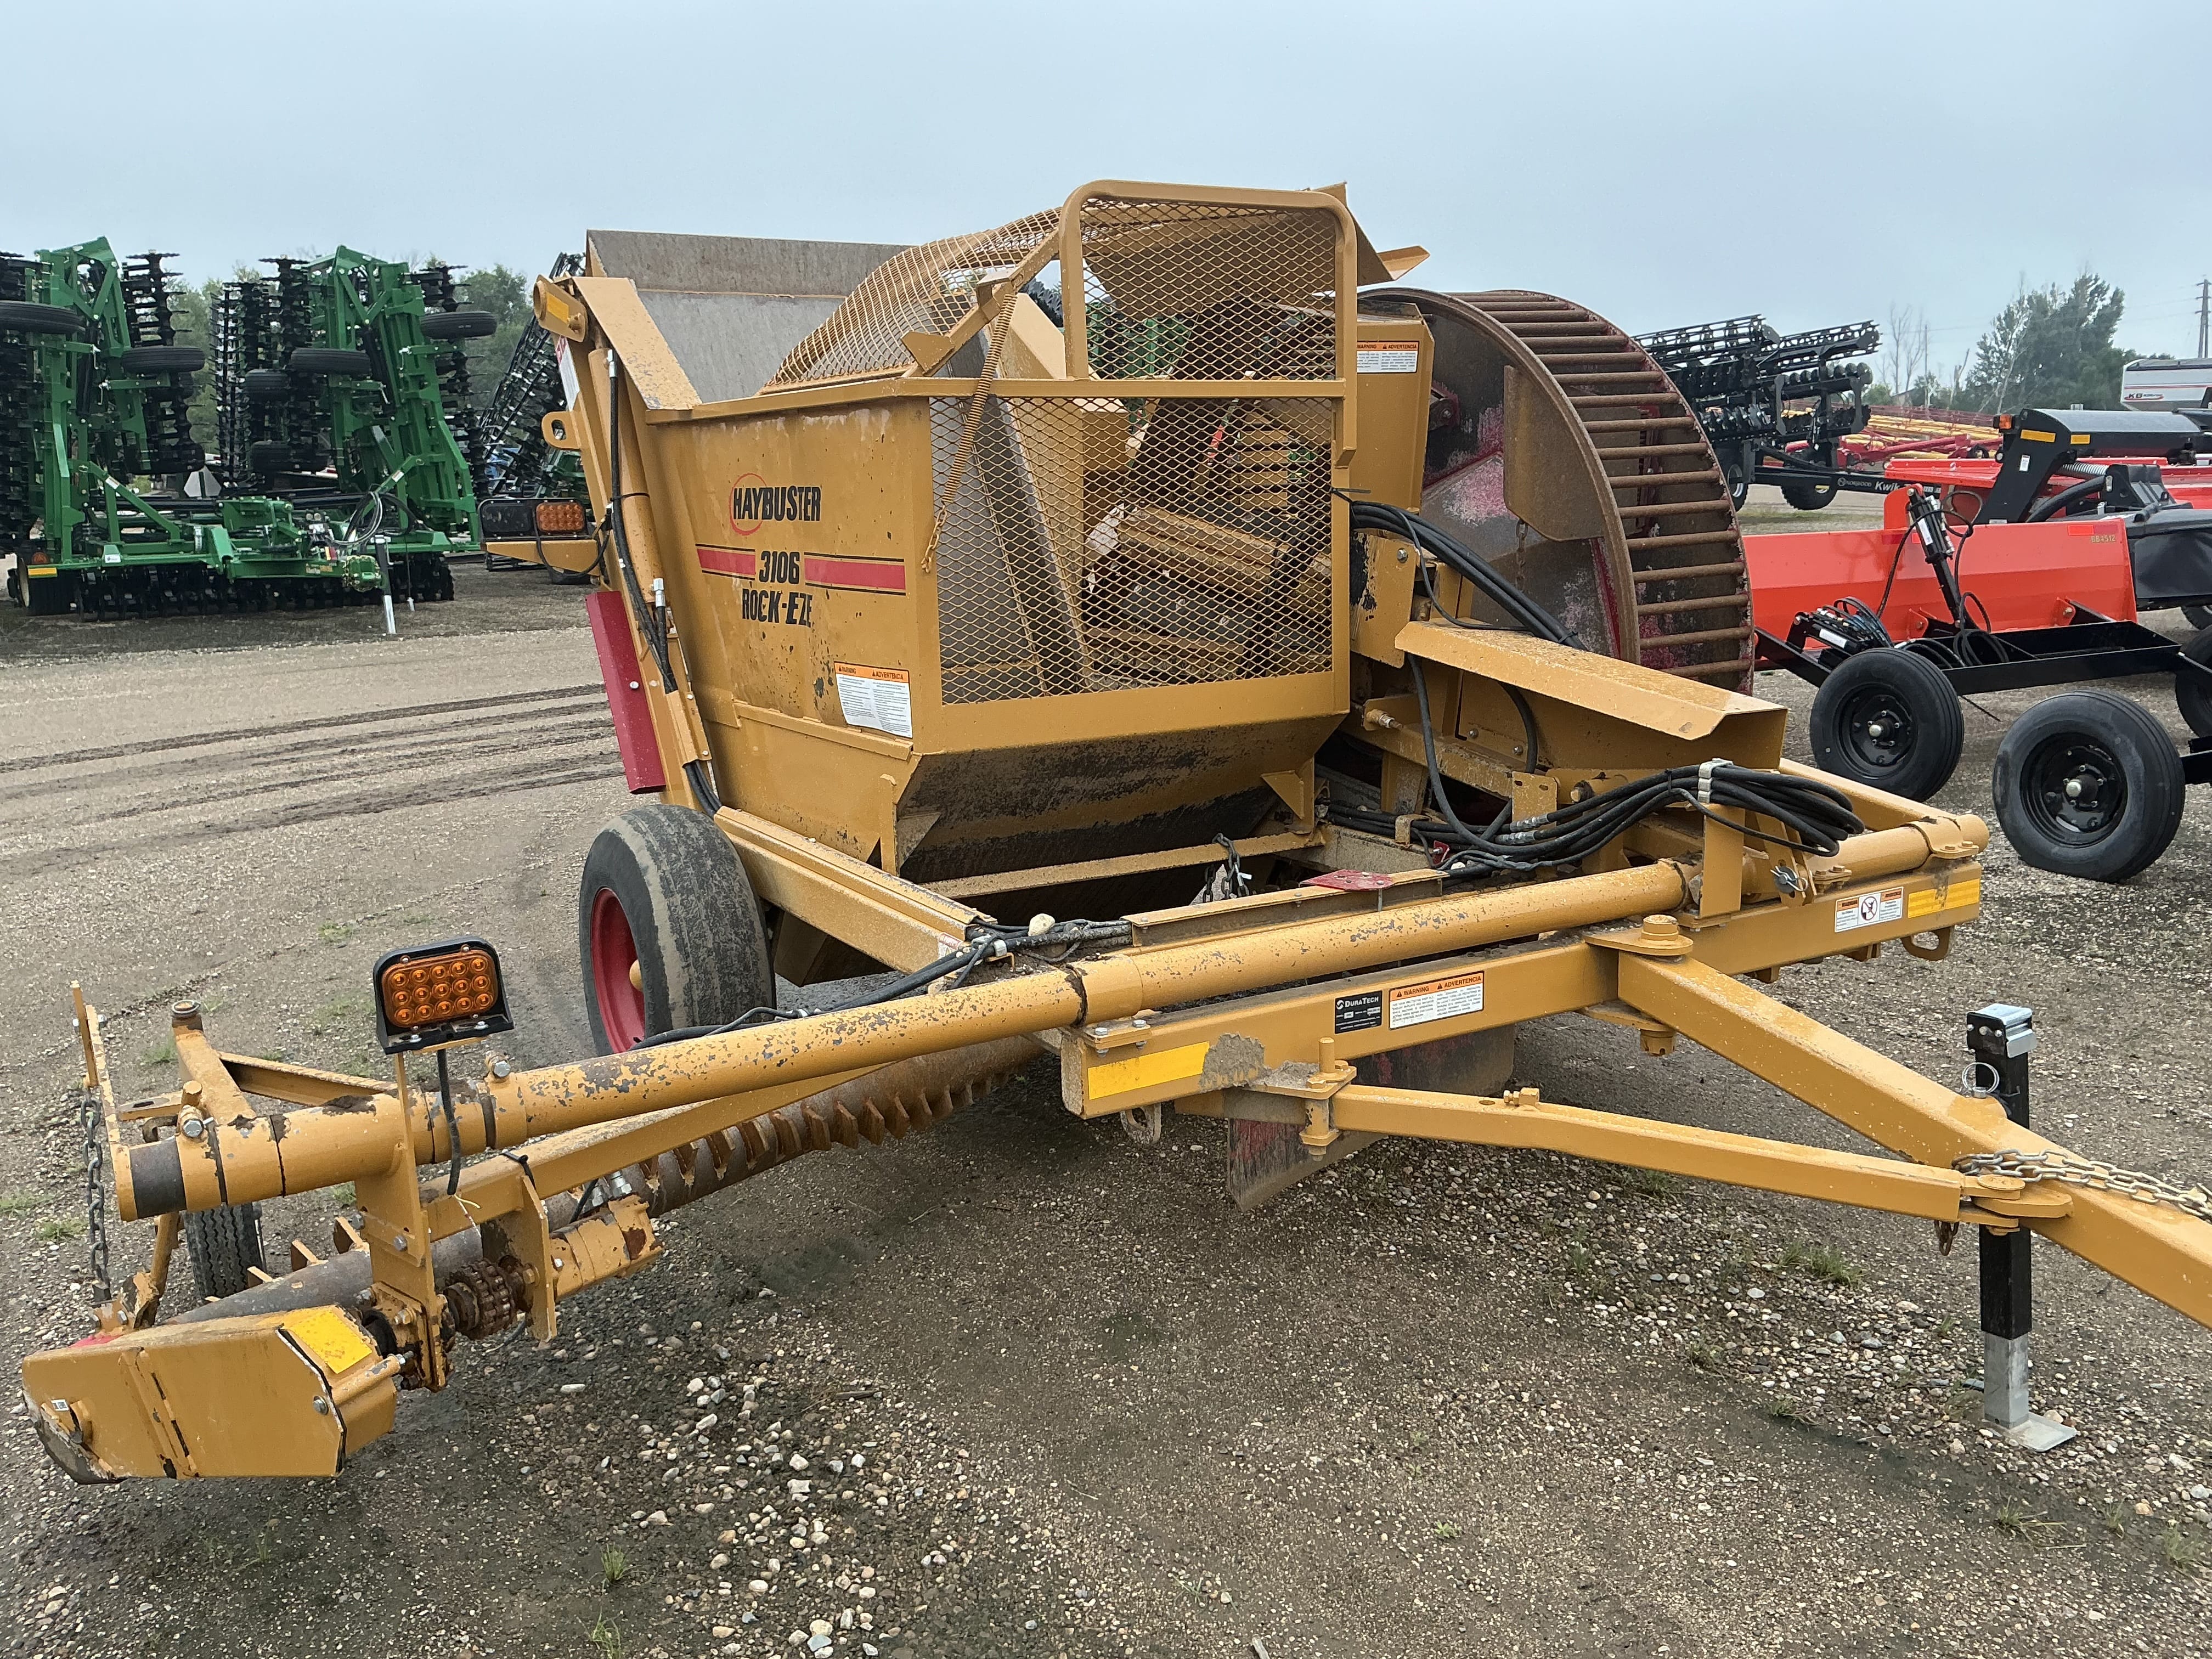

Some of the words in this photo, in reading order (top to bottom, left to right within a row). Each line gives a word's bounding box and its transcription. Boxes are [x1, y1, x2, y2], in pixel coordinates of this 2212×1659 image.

[1875, 481, 1900, 491] Kwik
[733, 486, 821, 521] HAYBUSTER
[759, 550, 800, 585] 3106
[742, 588, 813, 628] ROCK-EZE
[876, 672, 904, 680] ADVERTENCIA
[1403, 986, 1430, 996] WARNING
[1444, 976, 1481, 988] ADVERTENCIA
